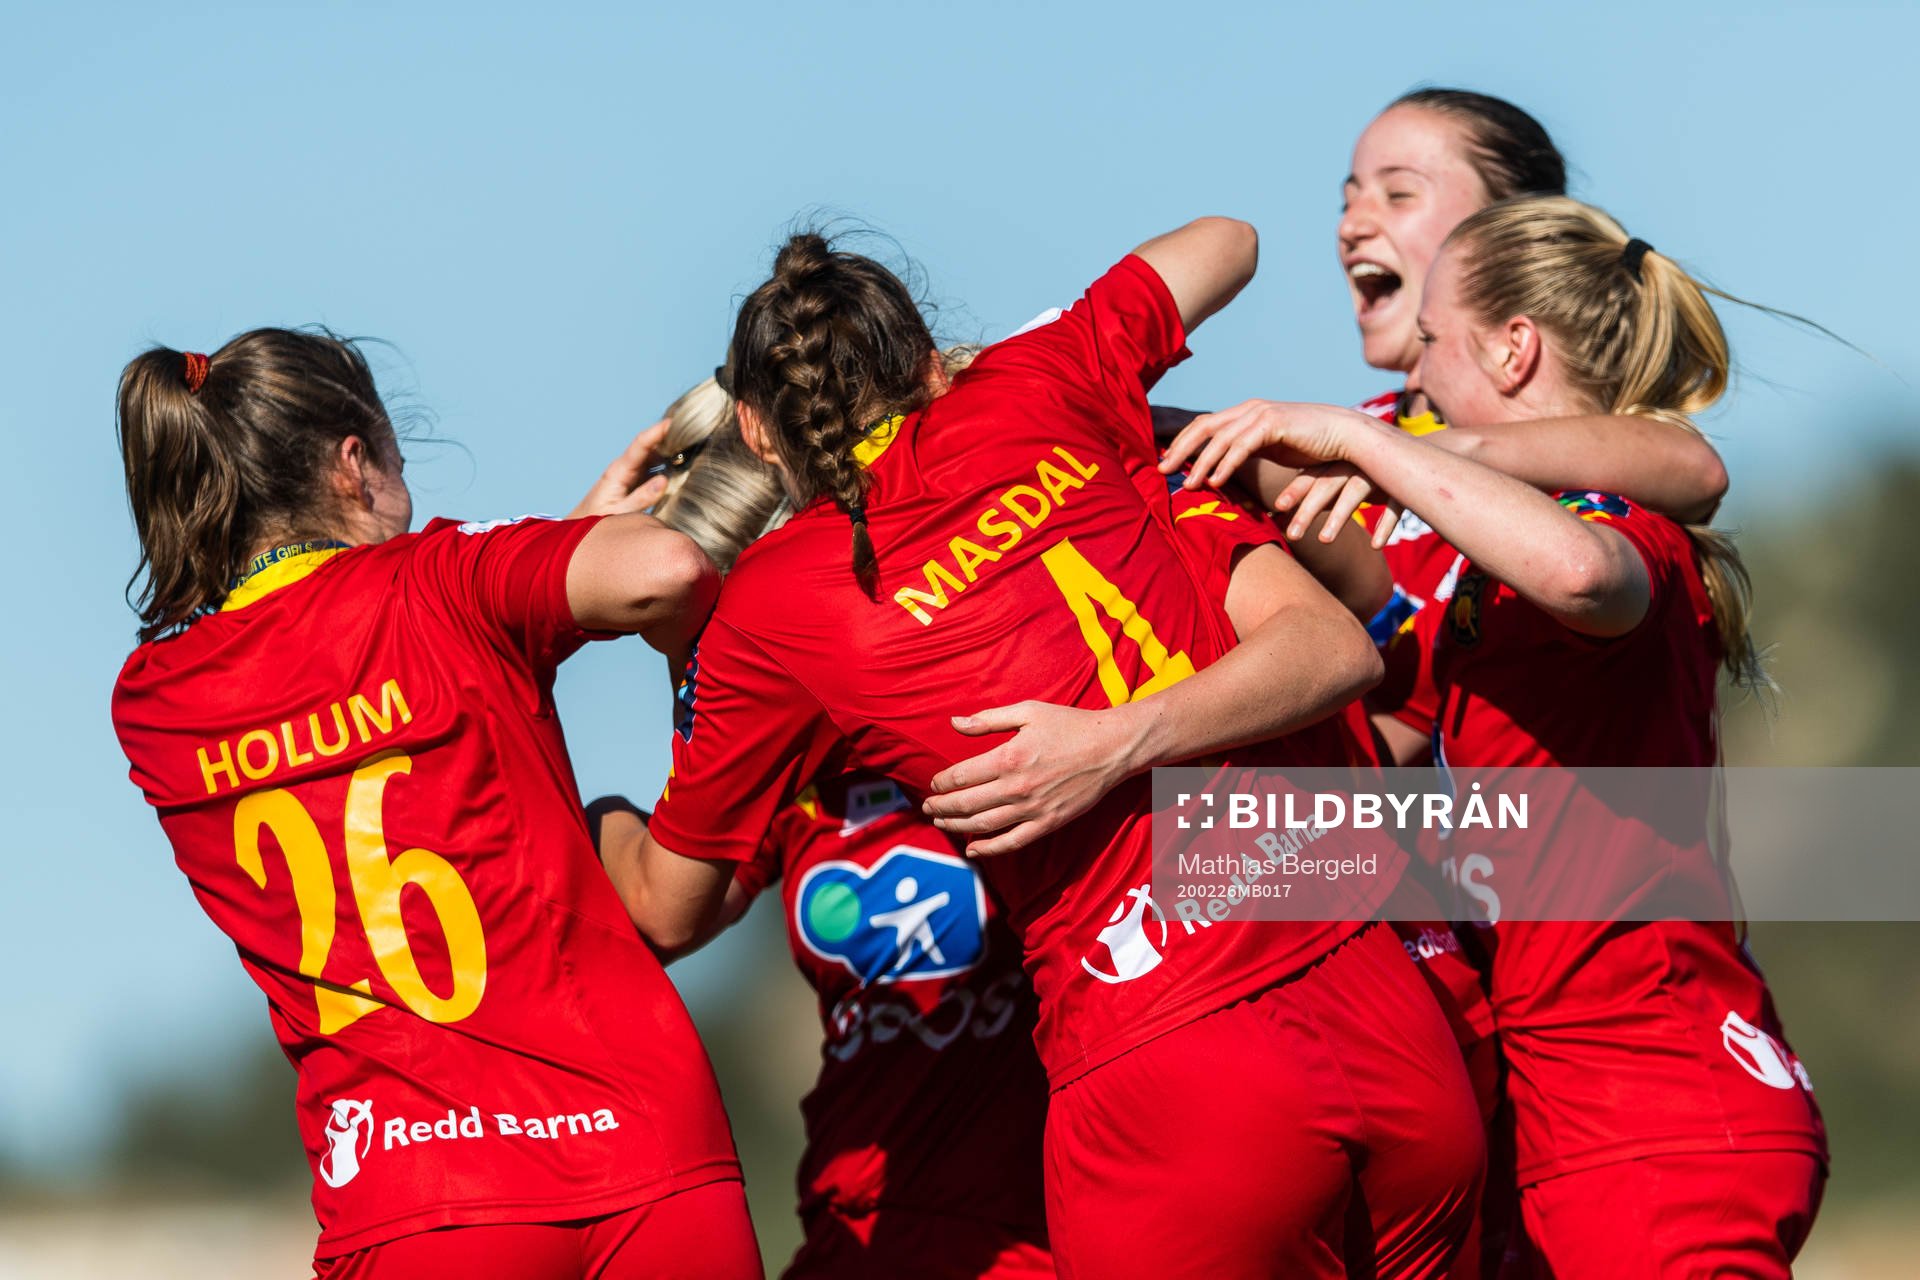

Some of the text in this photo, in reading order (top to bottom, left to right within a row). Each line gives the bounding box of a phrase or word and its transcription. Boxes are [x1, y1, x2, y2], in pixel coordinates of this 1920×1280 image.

[893, 444, 1101, 626] MASDAL
[1041, 538, 1196, 708] 4
[197, 679, 412, 794] HOLUM
[231, 752, 487, 1036] 26
[1174, 852, 1264, 935] Redd
[384, 1105, 619, 1151] Redd Barna
